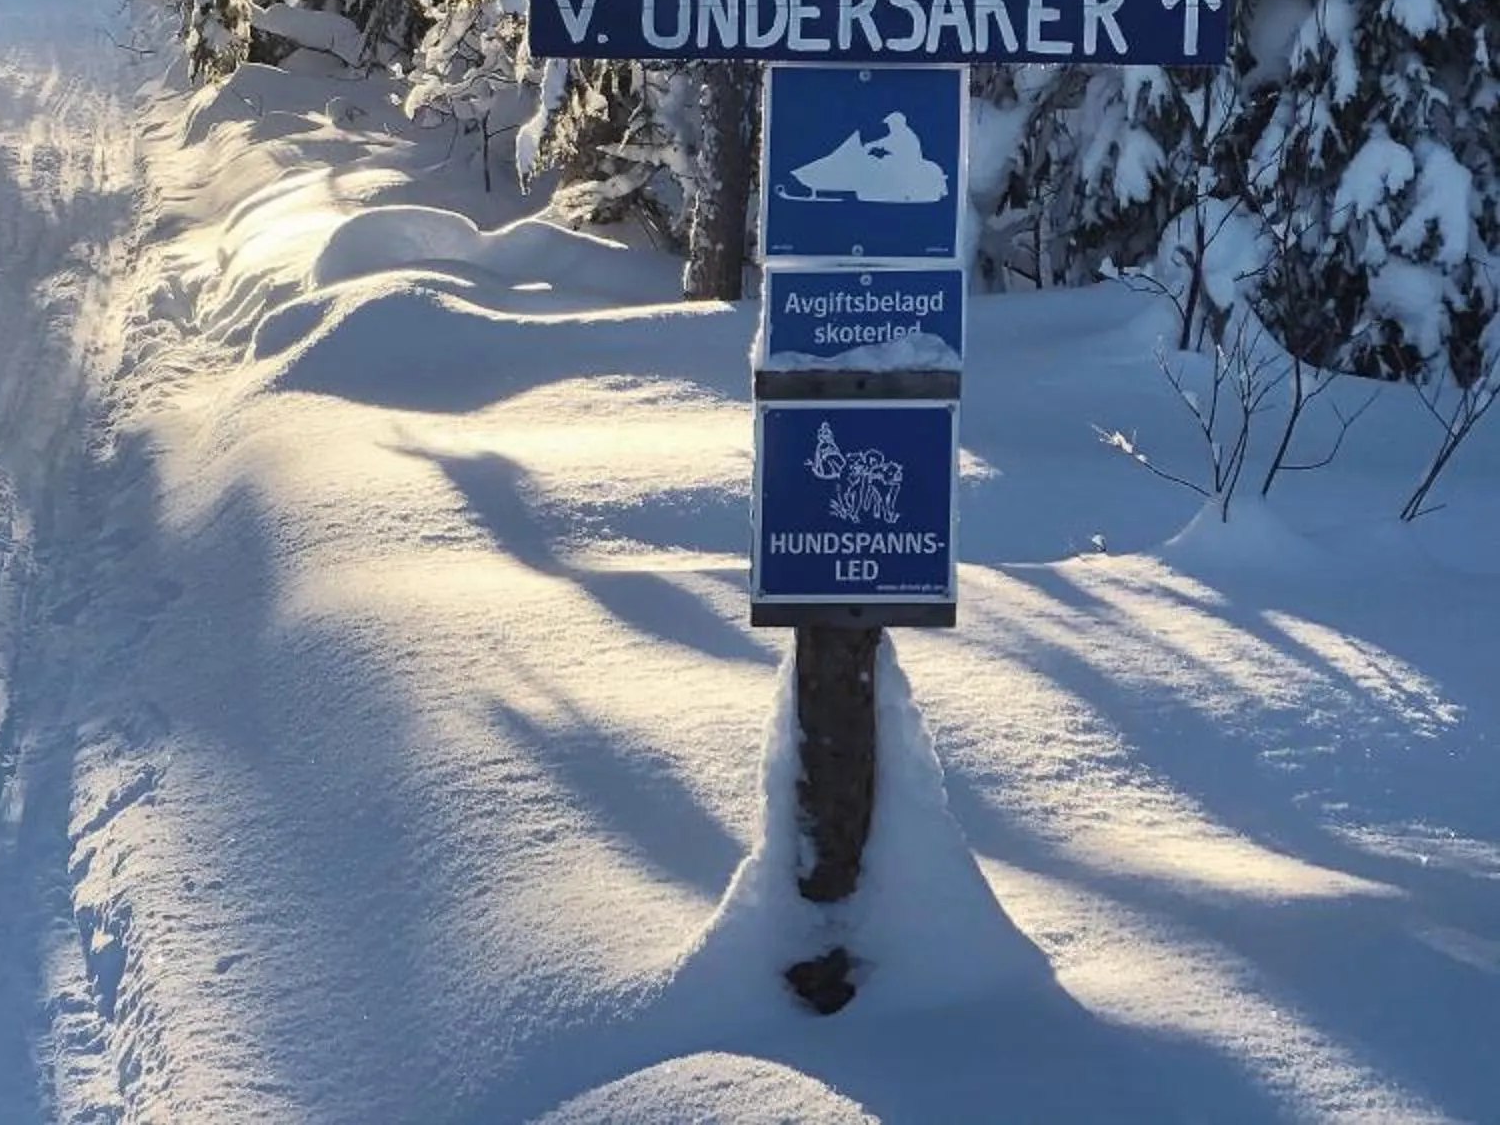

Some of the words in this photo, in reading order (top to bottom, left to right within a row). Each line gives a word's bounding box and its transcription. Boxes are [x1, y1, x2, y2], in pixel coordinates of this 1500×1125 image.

[784, 290, 945, 318] Avgiftsbelagd
[770, 532, 946, 555] HUNDSPANNS-
[835, 560, 879, 581] LED
